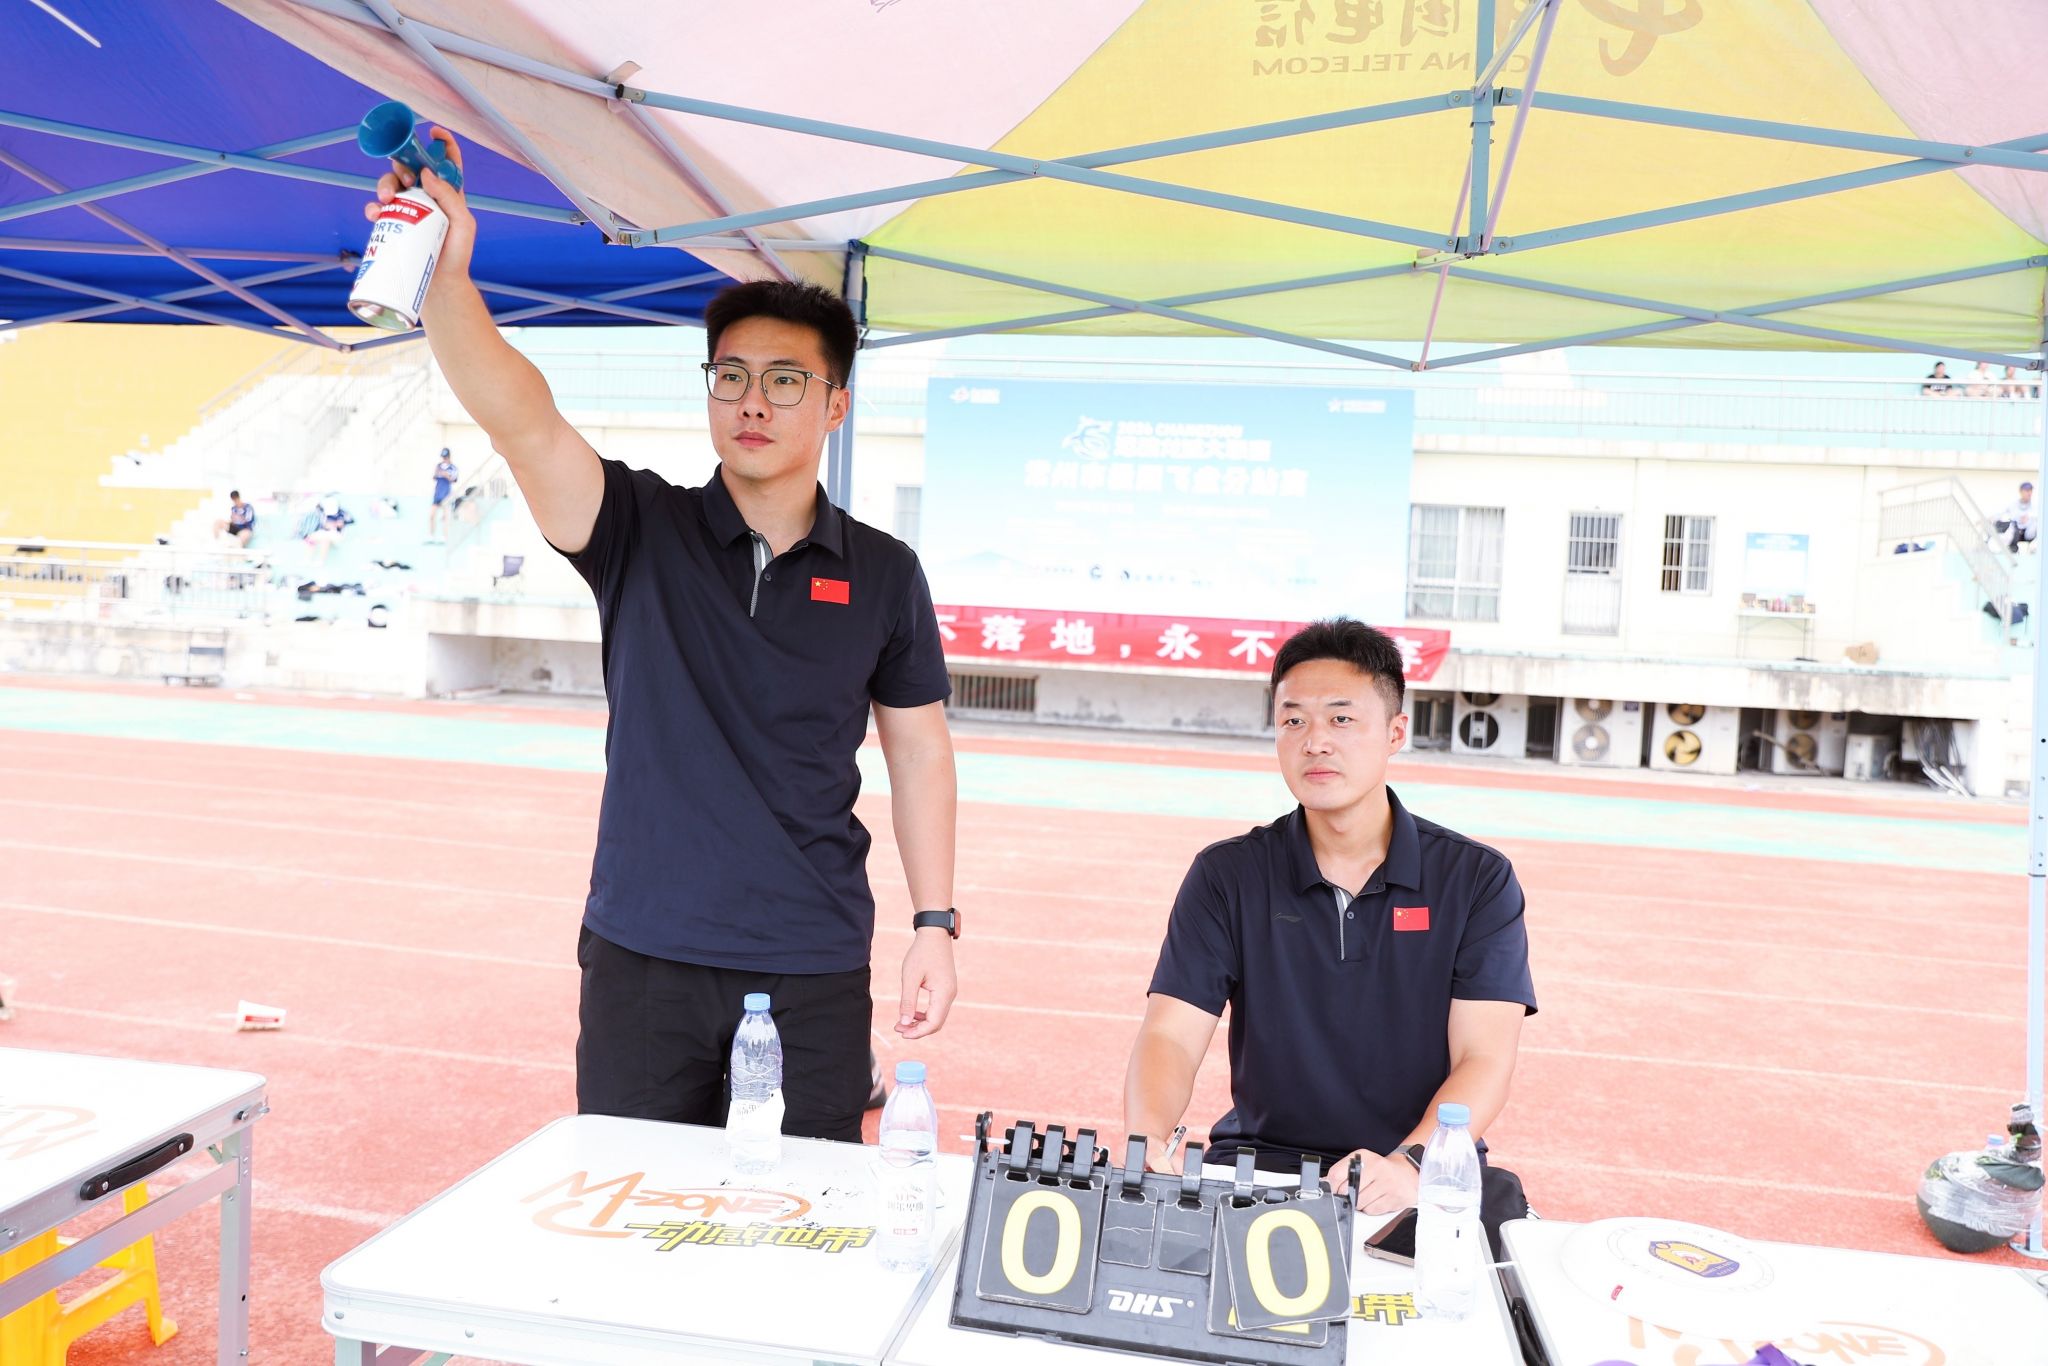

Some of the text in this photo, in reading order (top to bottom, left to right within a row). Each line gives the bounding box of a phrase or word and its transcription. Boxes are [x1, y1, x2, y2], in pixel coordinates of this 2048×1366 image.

[624, 1220, 877, 1253] 动感地带
[1001, 1190, 1081, 1294] 0
[1246, 1209, 1330, 1317] 0
[1107, 1289, 1184, 1318] DHS
